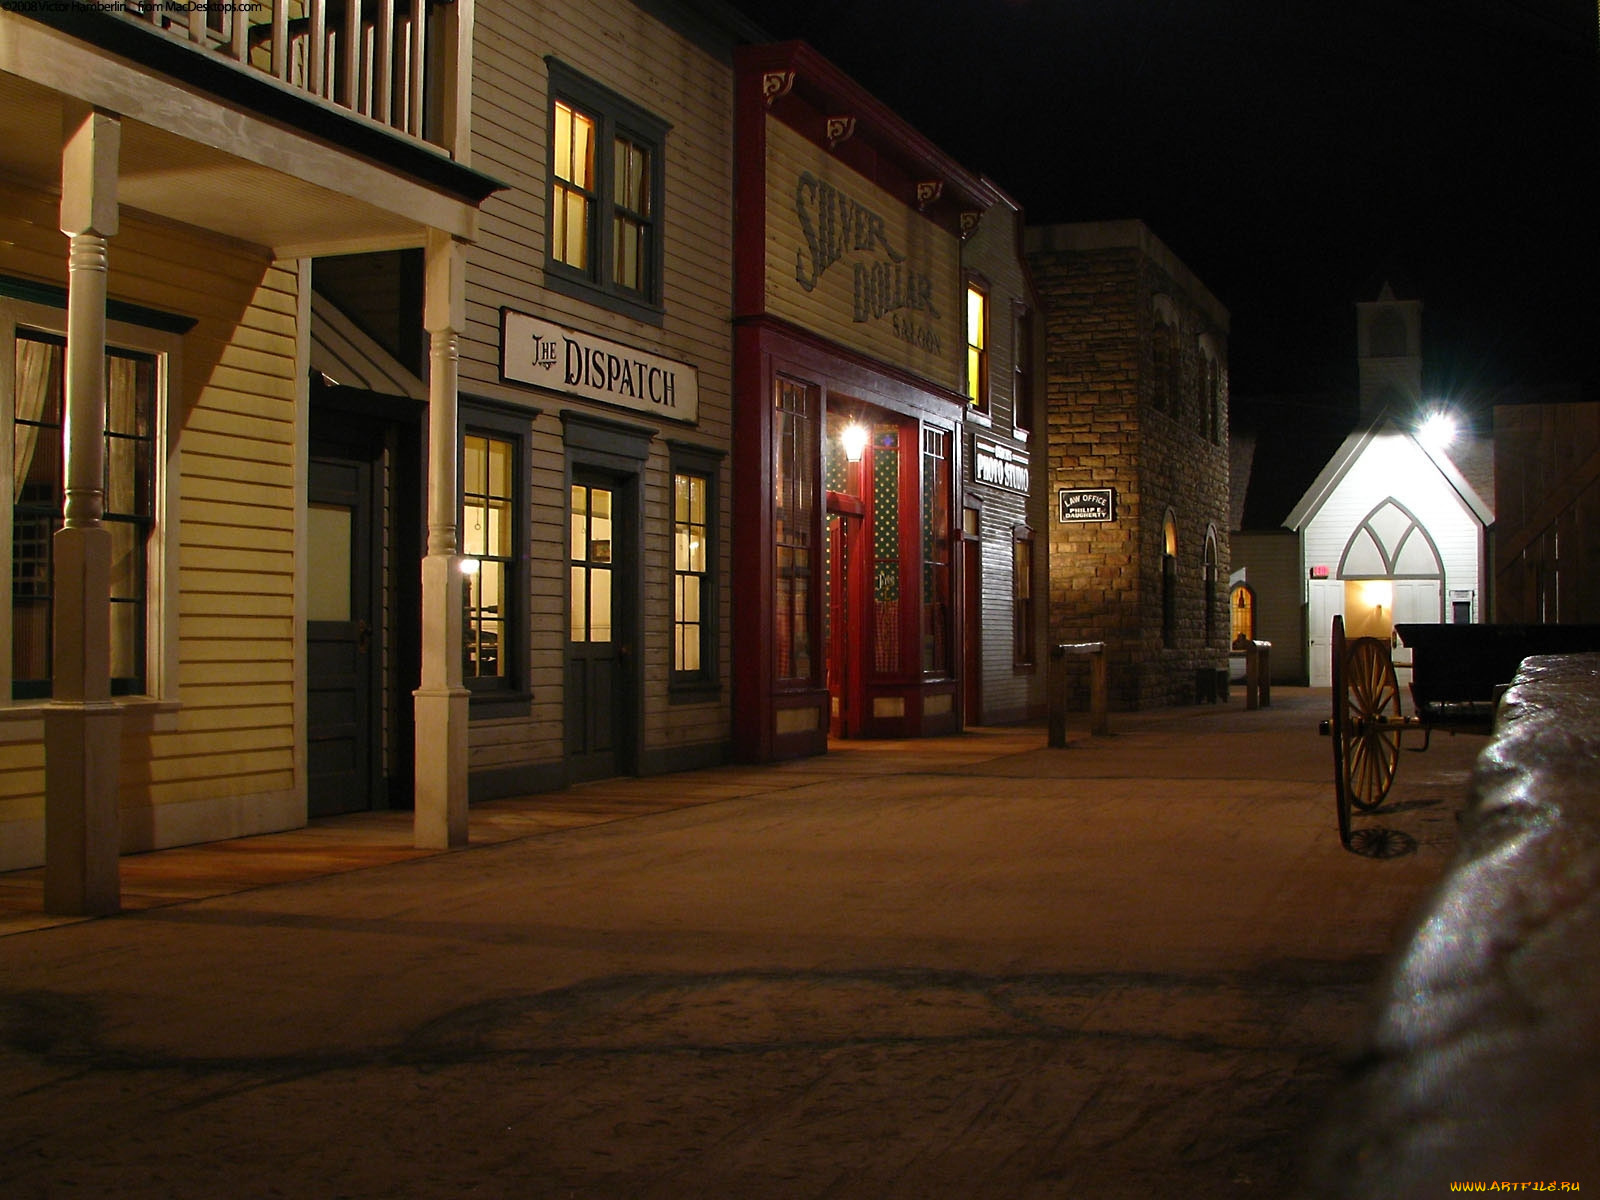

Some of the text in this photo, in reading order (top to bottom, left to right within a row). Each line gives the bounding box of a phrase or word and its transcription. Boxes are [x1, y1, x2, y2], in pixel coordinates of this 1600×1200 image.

[796, 170, 906, 292] SILVER
[853, 262, 941, 322] DOLLAR
[893, 314, 941, 354] SALOON
[532, 333, 675, 408] THE DISPATCH
[977, 453, 1029, 492] PHOTO STUDIO
[1064, 494, 1107, 508] LAW OFFICE
